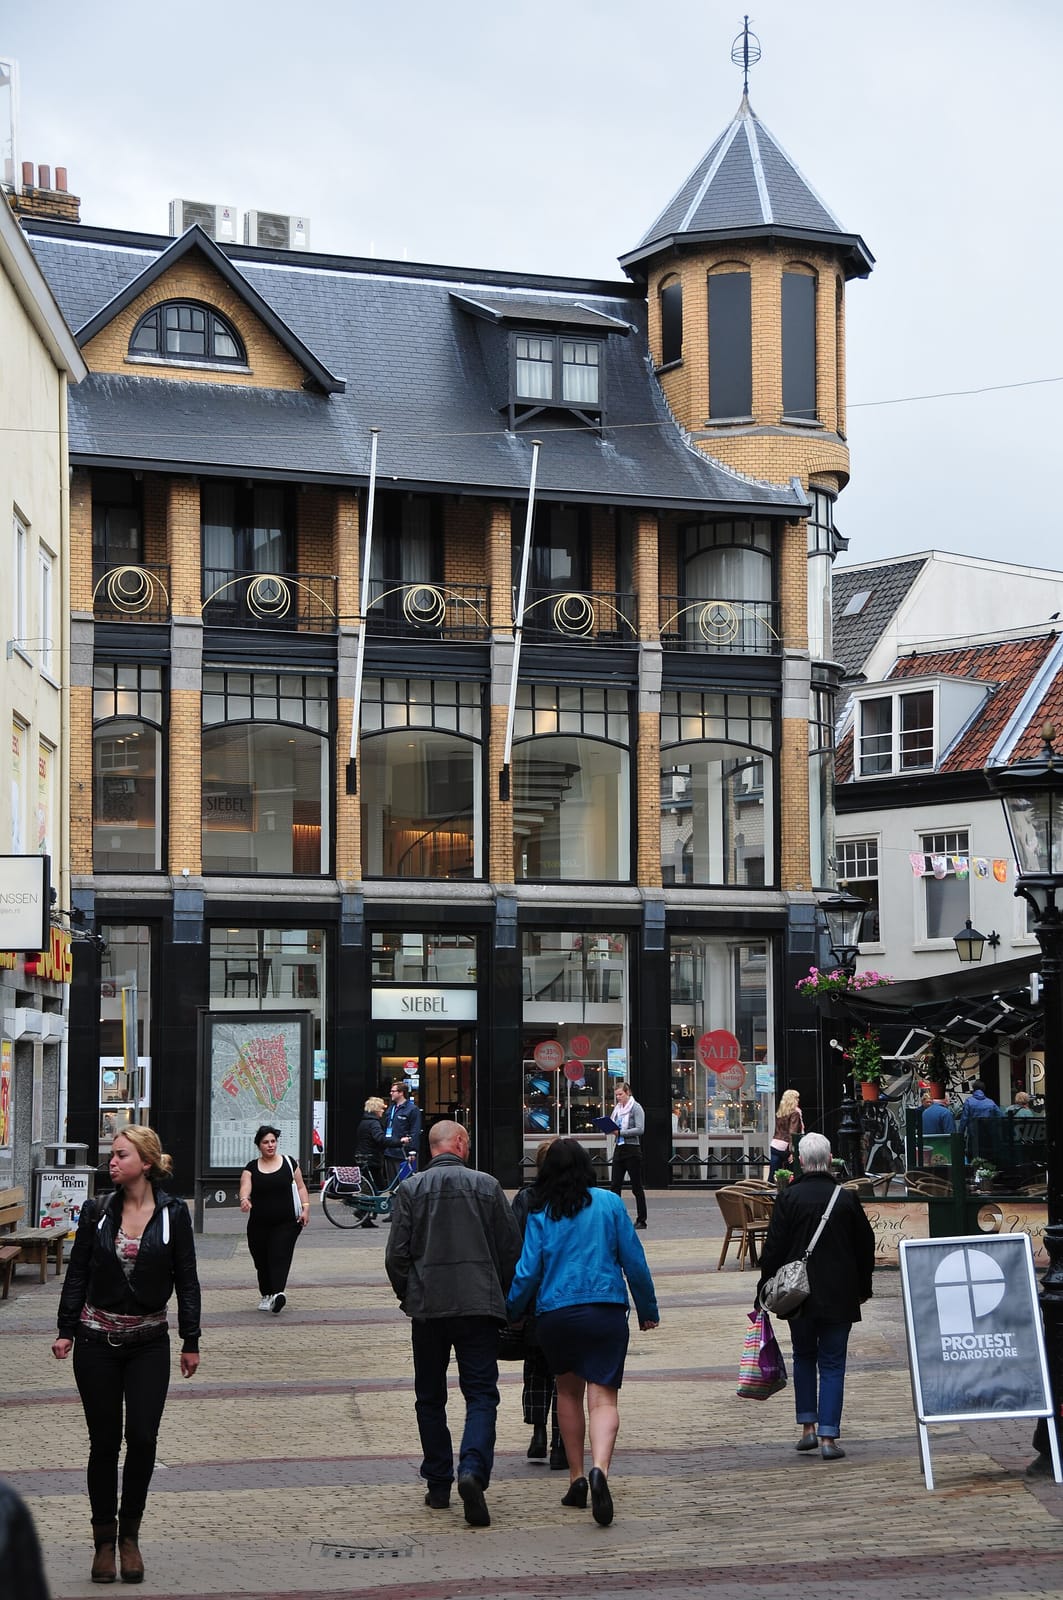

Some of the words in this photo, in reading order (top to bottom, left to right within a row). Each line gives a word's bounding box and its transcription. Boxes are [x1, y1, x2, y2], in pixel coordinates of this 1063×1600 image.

[206, 796, 248, 812] SIEBEL
[401, 996, 449, 1013] SIEBEL
[700, 1045, 738, 1058] SALE
[43, 1173, 76, 1181] sundae
[941, 1333, 1012, 1351] PROTEST
[942, 1347, 1018, 1361] BOARDSTORE
